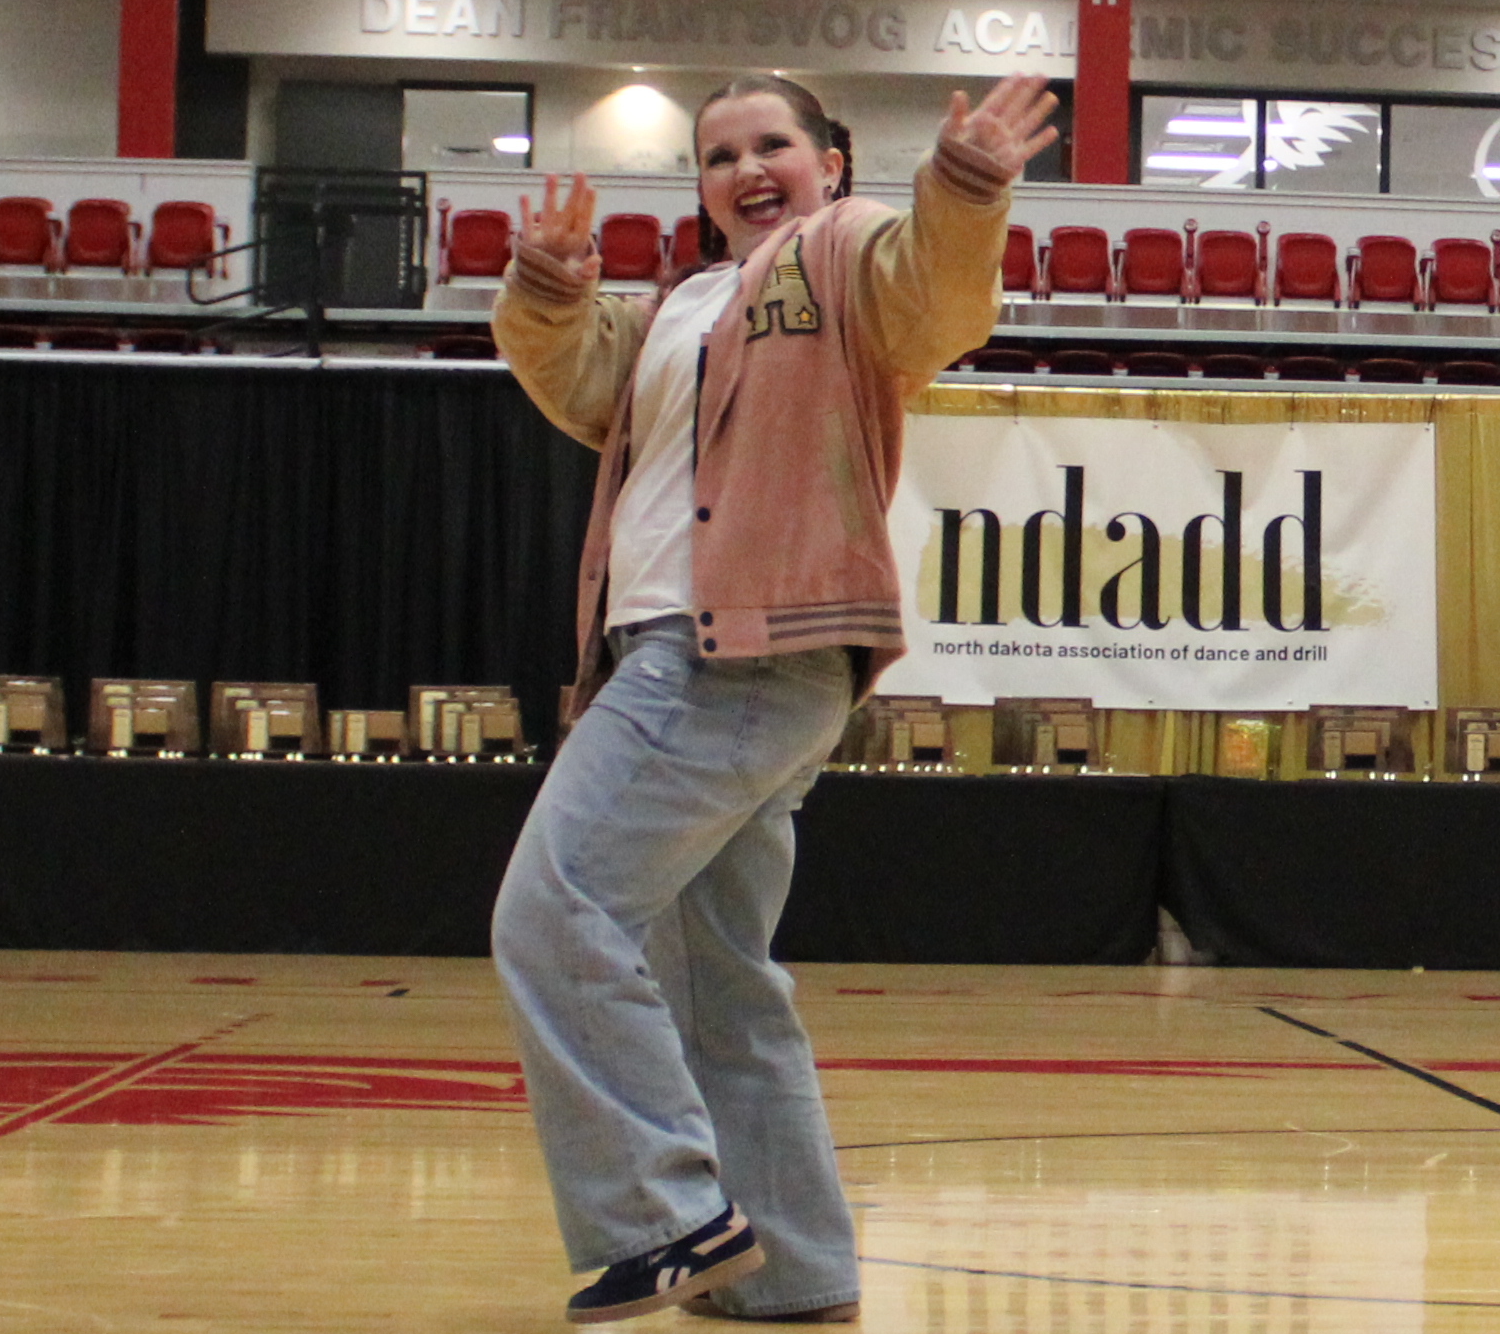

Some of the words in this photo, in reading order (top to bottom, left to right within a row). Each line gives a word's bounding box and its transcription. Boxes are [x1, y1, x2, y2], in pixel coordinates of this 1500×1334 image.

[930, 464, 1331, 634] ndadd
[933, 640, 984, 657] north
[988, 641, 1055, 659] dakota
[1059, 642, 1166, 661] association
[1170, 642, 1190, 660] of
[1194, 644, 1250, 662] dance
[1255, 644, 1289, 662] and
[1293, 644, 1329, 662] drill
